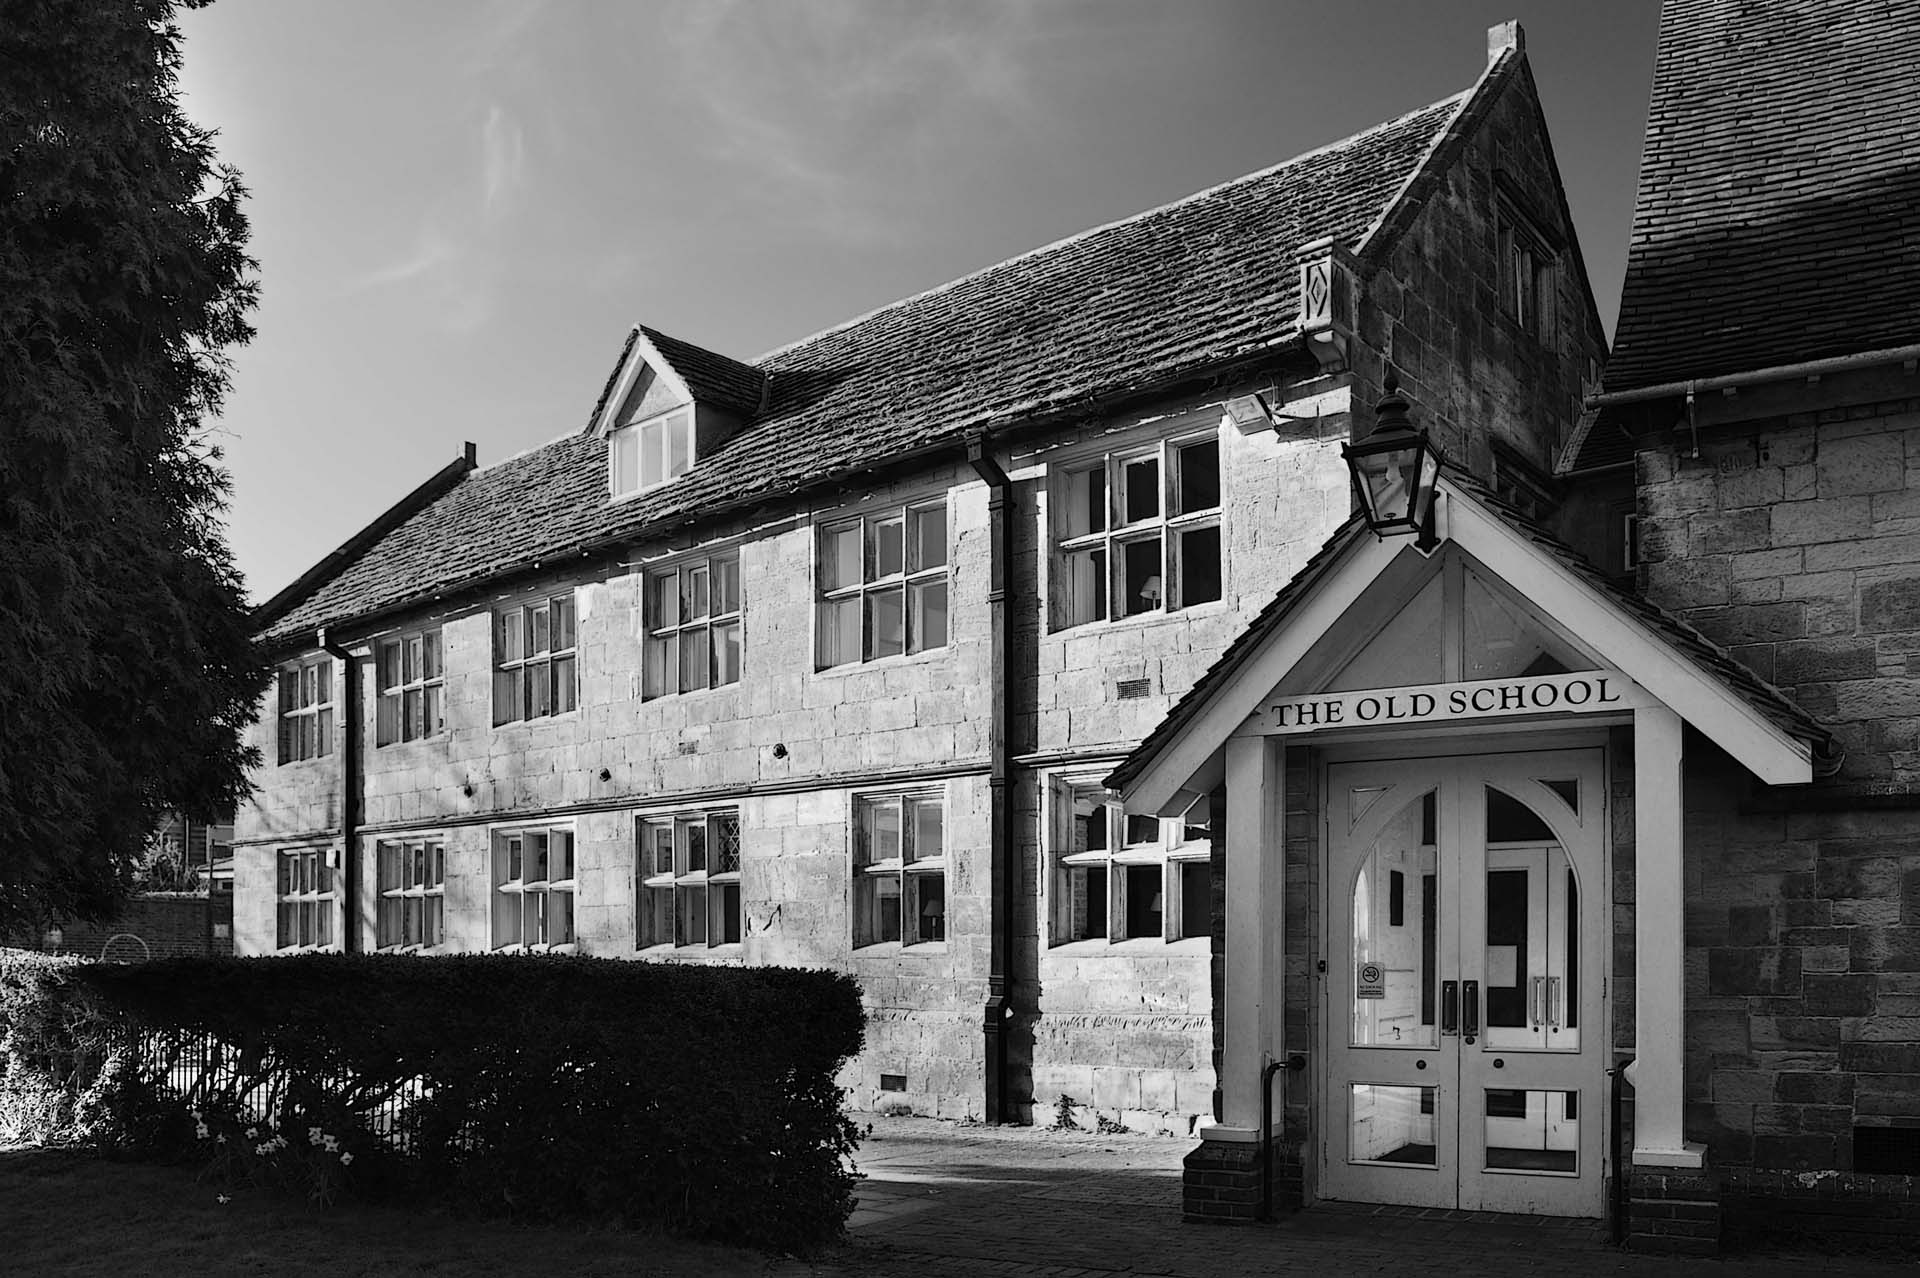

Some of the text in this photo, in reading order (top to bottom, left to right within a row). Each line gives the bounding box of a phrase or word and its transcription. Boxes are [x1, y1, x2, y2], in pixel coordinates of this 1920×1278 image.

[1271, 678, 1621, 728] THE OLD SCHOOL
